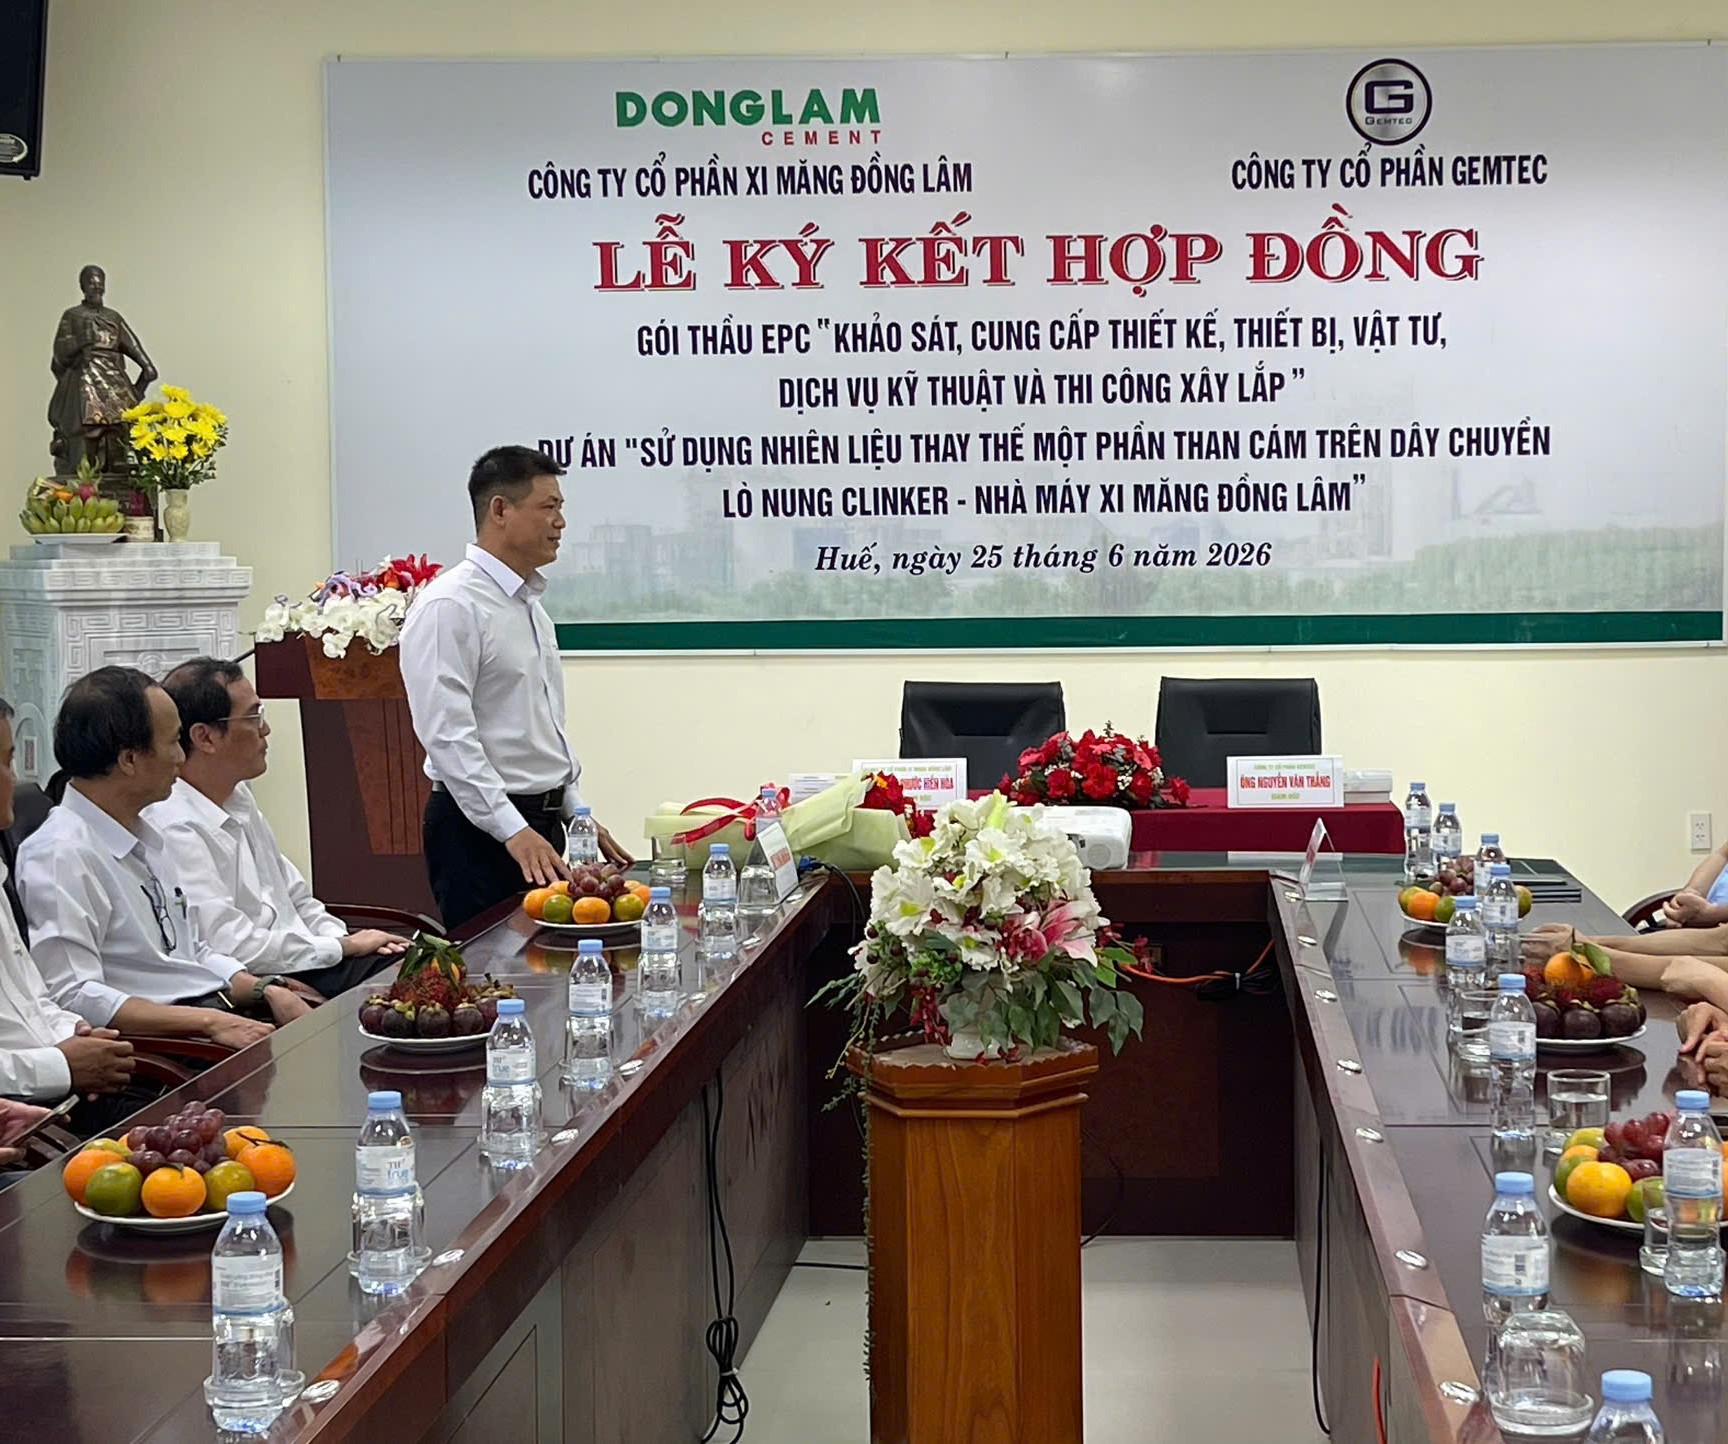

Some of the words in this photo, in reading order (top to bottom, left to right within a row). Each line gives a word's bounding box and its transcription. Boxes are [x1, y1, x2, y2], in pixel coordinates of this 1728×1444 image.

[615, 88, 881, 128] DONGLAM
[761, 129, 881, 146] CEMENT
[527, 160, 592, 200] CÔNG
[596, 167, 628, 198] TY
[635, 150, 667, 198] CỔ
[674, 152, 739, 197] PHẦN
[745, 165, 769, 196] XI
[776, 158, 844, 196] MĂNG
[850, 150, 915, 195] ĐỒNG
[922, 154, 973, 193] LÂM
[1231, 151, 1295, 190] CÔNG
[1301, 158, 1332, 189] TY
[1339, 141, 1371, 189] CỔ
[1380, 143, 1444, 188] PHẦN
[1451, 154, 1548, 187] GEMTEC
[591, 212, 697, 293] LỄ
[721, 221, 836, 291] KÝ
[857, 210, 1025, 289] KẾT
[1045, 223, 1224, 299] HỢP
[1245, 202, 1486, 284] ĐỒNG
[637, 318, 680, 357] GÓI
[686, 313, 753, 356] THẦU
[761, 322, 811, 355] EPC
[911, 314, 963, 356] SÁT,
[971, 319, 1041, 352] CUNG
[1049, 307, 1100, 351] CẤP
[1107, 307, 1178, 350] THIẾT
[1185, 307, 1225, 353] KẾ,
[1233, 306, 1303, 349] THIẾT
[1311, 316, 1345, 355] BỊ,
[1352, 308, 1401, 354] VẬT
[1407, 311, 1447, 350] TƯ,
[778, 377, 839, 415] DỊCH
[846, 376, 879, 415] VỤ
[887, 369, 919, 407] KỸ
[926, 368, 1006, 413] THUẬT
[1013, 367, 1047, 405] VÀ
[1053, 373, 1093, 405] THI
[1101, 366, 1172, 405] CÔNG
[1179, 365, 1230, 404] XÂY
[580, 431, 617, 468] ÁN
[682, 435, 753, 473] DỤNG
[760, 428, 840, 466] NHIÊN
[848, 427, 902, 471] LIỆU
[909, 432, 971, 464] THAY
[978, 422, 1026, 463] THẾ
[1033, 425, 1088, 469] MỘT
[1095, 420, 1166, 461] PHẦN
[1173, 430, 1240, 461] THAN
[1249, 423, 1307, 460] CÁM
[1315, 422, 1381, 459] TRÊN
[1390, 421, 1440, 458] DÂY
[1448, 415, 1551, 458] CHUYỀN
[722, 481, 753, 519] LÒ
[761, 487, 833, 518] NUNG
[841, 485, 949, 517] CLINKER
[974, 478, 1028, 515] NHÀ
[1035, 477, 1091, 514] MÁY
[1099, 483, 1124, 514] XI
[1132, 476, 1209, 513] MĂNG
[1216, 472, 1288, 513] ĐỒNG
[814, 541, 881, 575] Huế,
[892, 544, 962, 576] ngày
[970, 544, 1004, 569] 25
[1013, 543, 1099, 574] tháng
[1108, 543, 1125, 568] 6
[1133, 543, 1198, 567] năm
[1205, 541, 1273, 567] 2026
